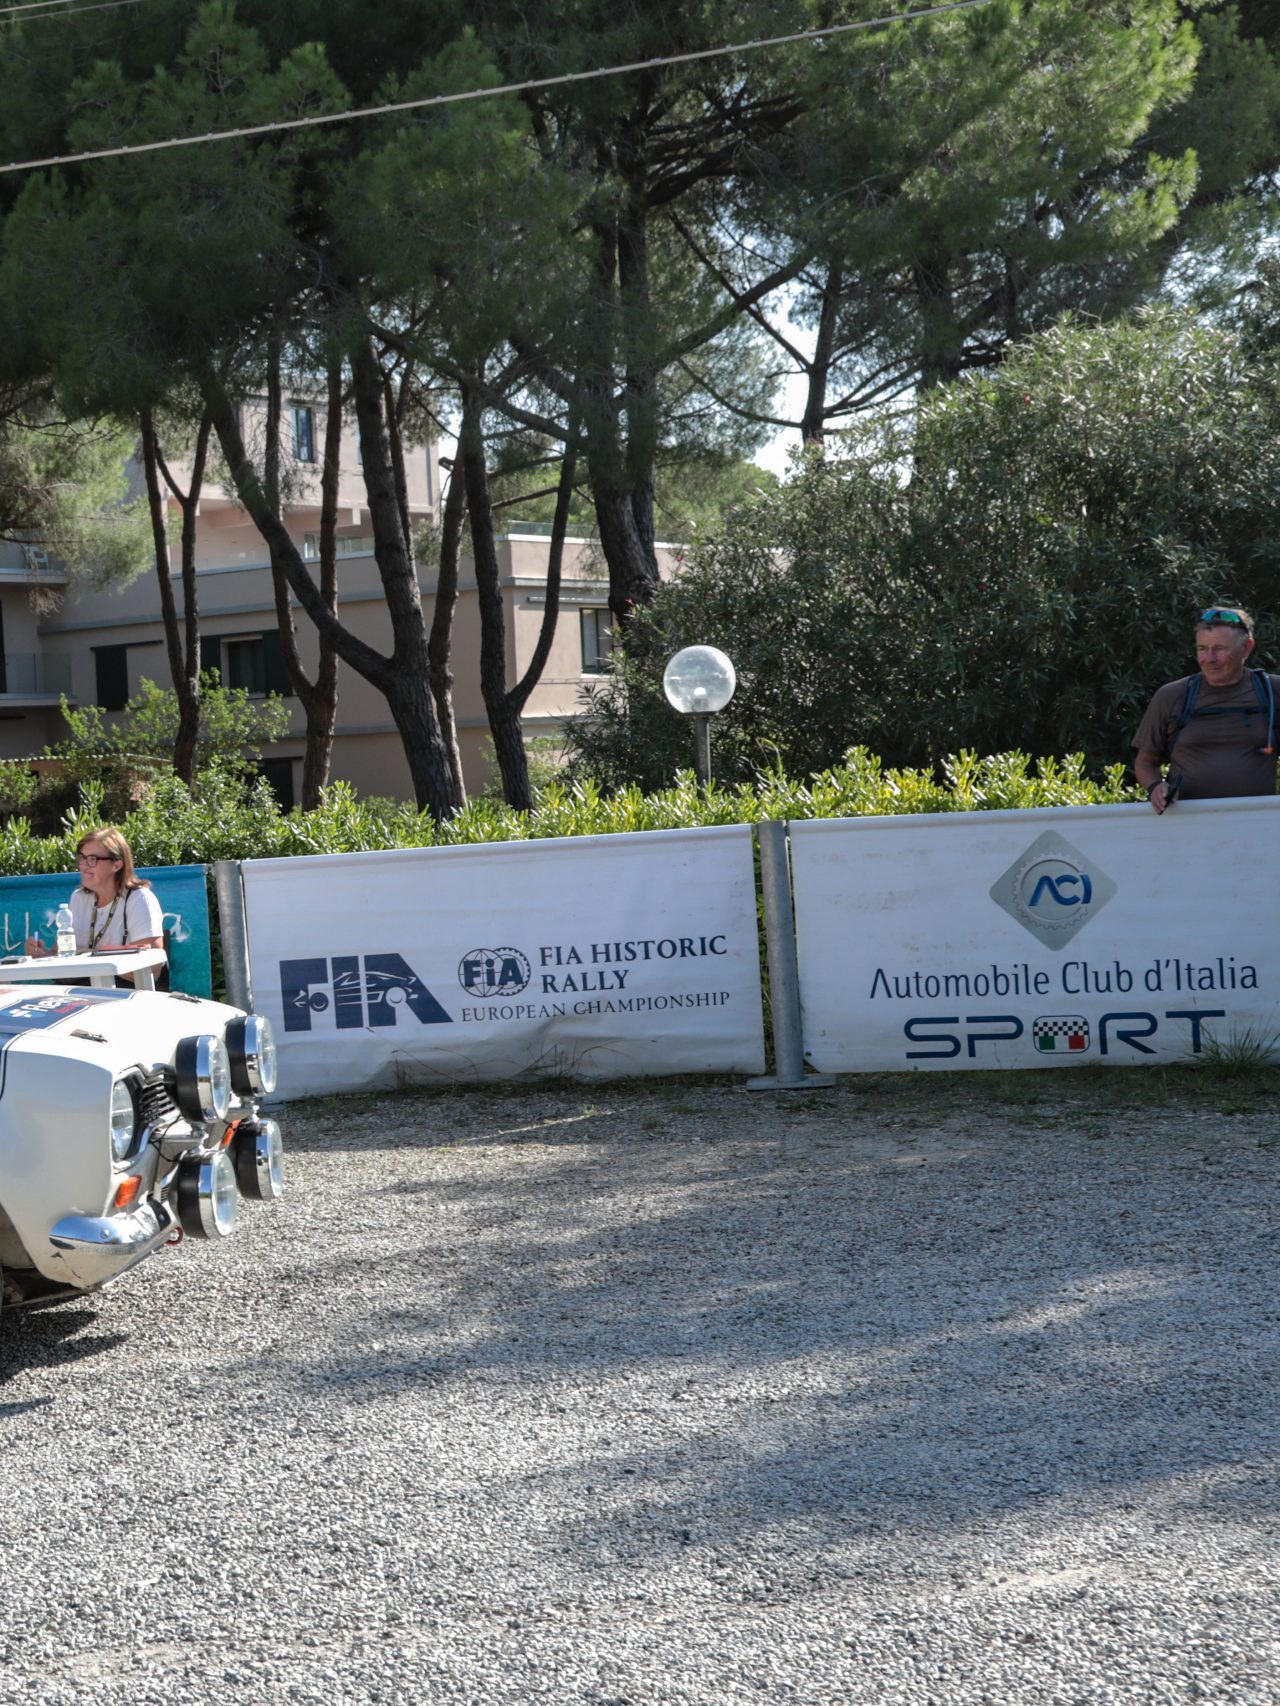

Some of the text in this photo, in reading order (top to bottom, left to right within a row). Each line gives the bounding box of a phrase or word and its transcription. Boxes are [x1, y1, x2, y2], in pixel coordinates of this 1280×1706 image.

[1028, 873, 1093, 907] ACI
[539, 934, 728, 966] FIA HISTORIC
[280, 952, 453, 1032] FIA
[540, 969, 630, 994] RALLY
[869, 956, 1260, 999] Automobile Club d'Italia
[461, 991, 731, 1023] EUROPEAN CHAMPIONSHIP
